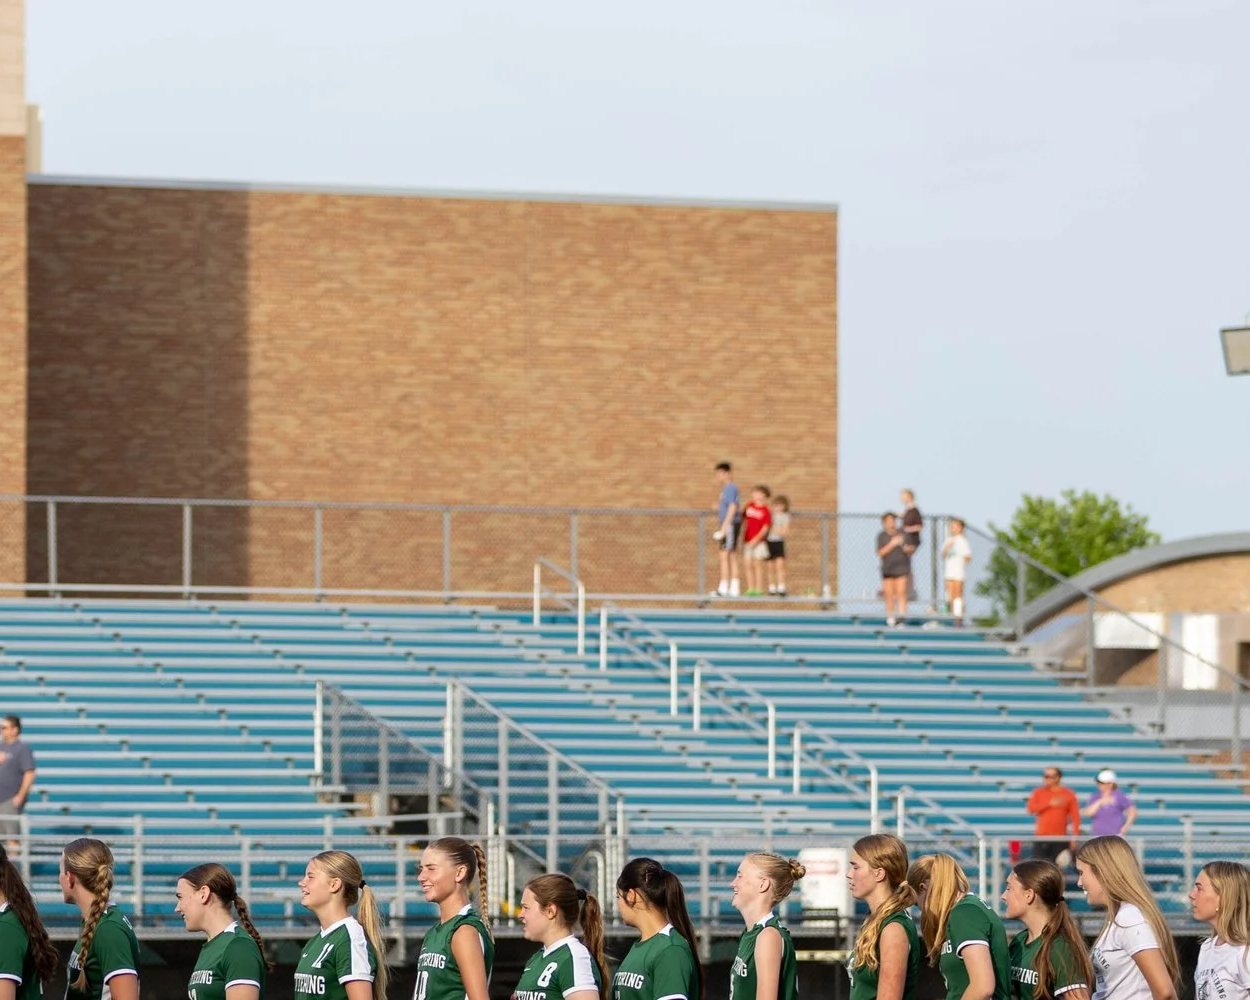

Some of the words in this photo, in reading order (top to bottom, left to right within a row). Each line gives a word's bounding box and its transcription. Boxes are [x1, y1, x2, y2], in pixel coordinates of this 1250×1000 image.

[312, 943, 334, 969] 11
[414, 970, 429, 1000] 10
[537, 962, 558, 987] 8
